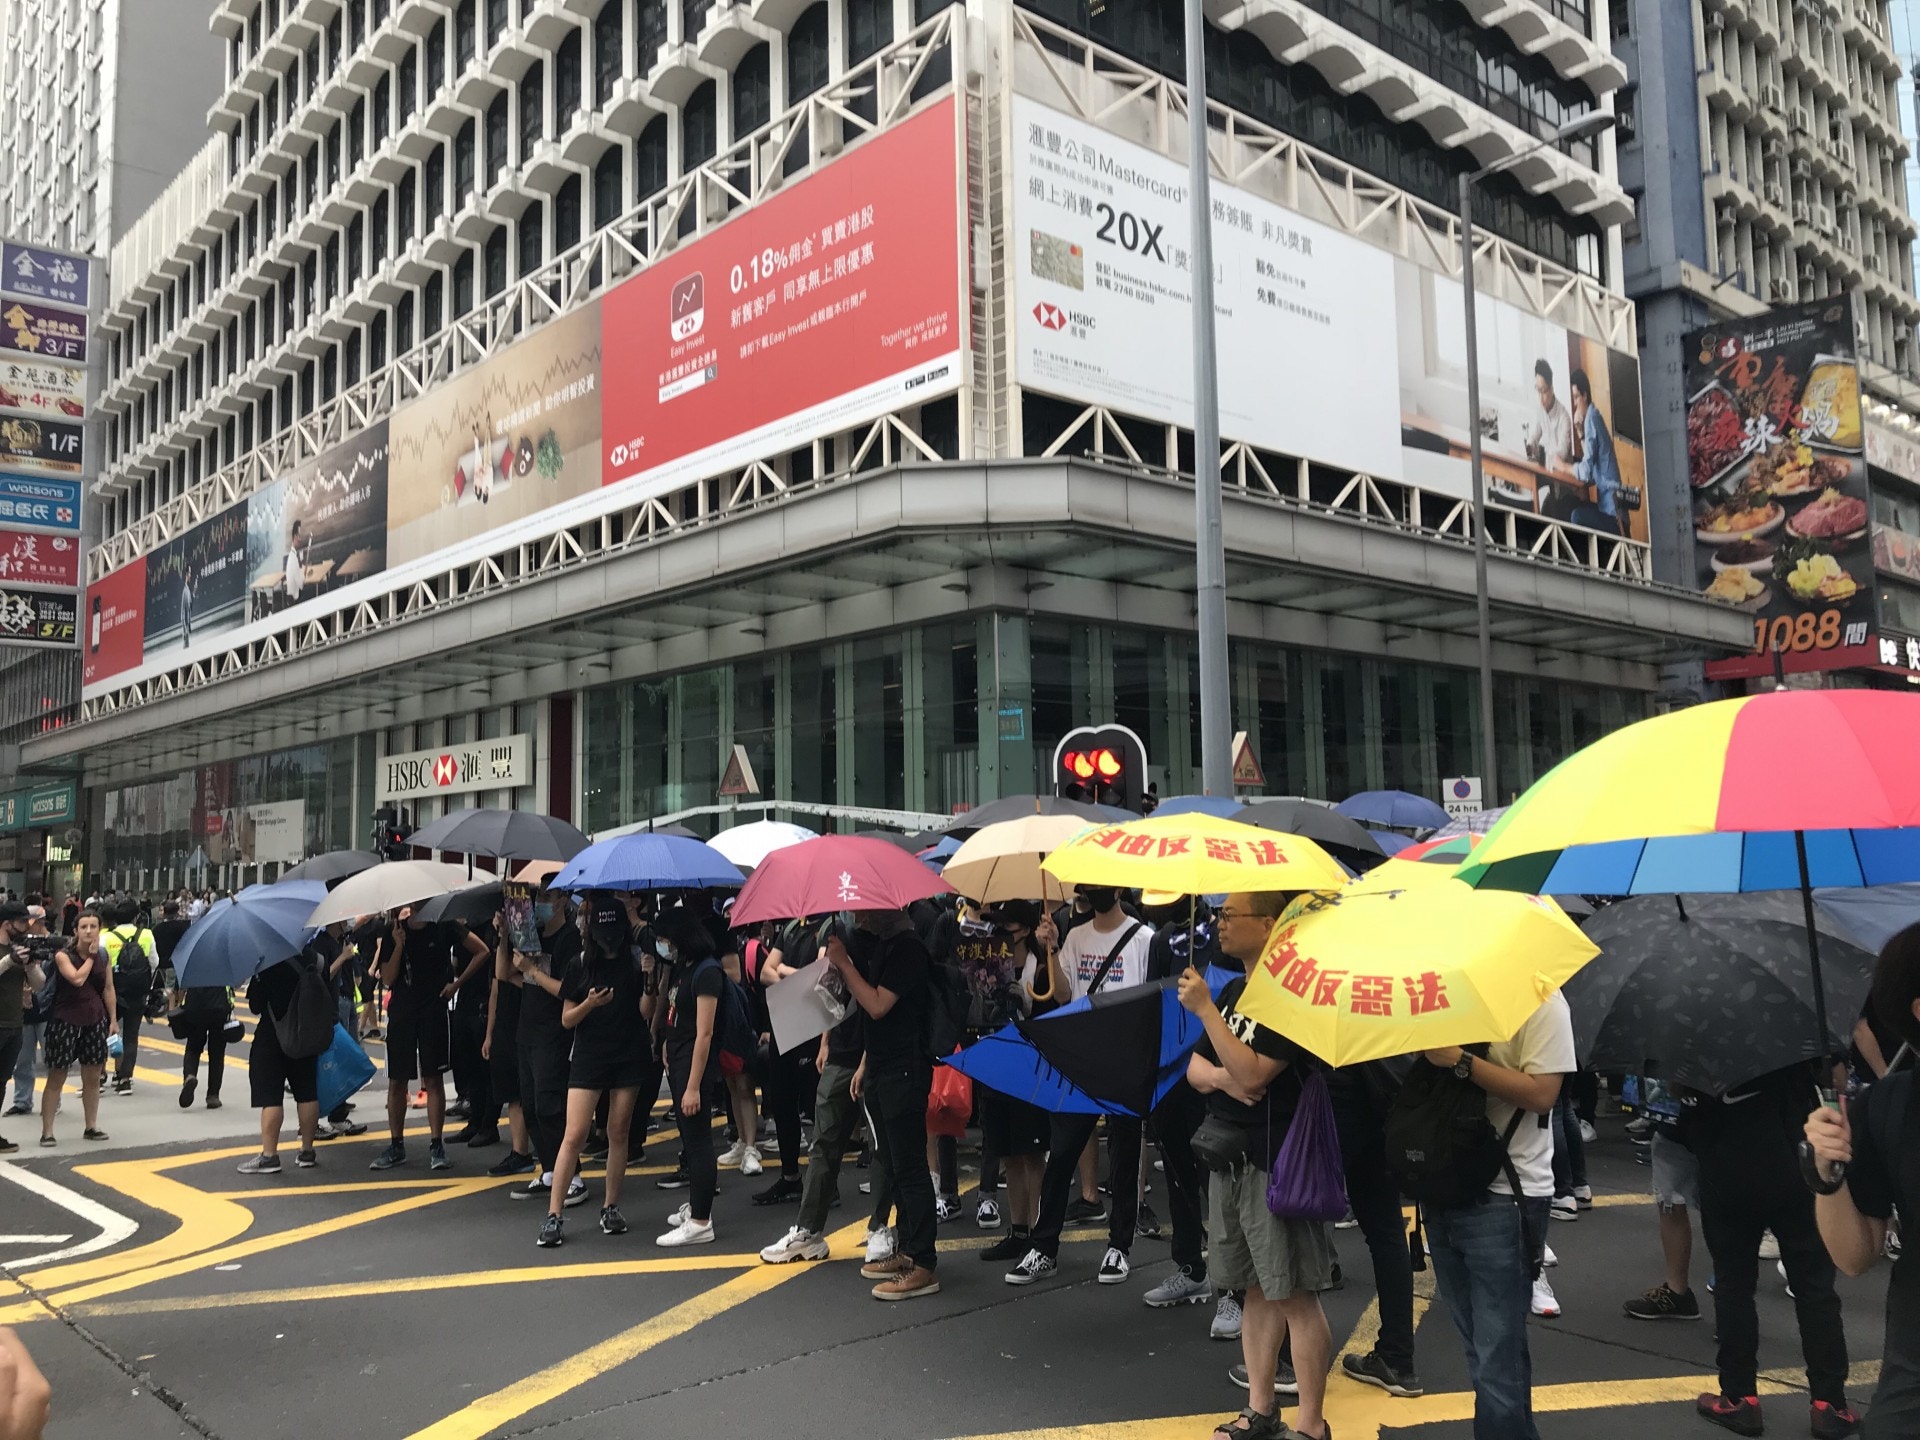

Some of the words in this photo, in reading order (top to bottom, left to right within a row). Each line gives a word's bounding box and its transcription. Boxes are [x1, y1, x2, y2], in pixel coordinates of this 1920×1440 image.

[1029, 122, 1096, 171] 滙豐公司
[1262, 219, 1313, 257] 非凡獎賞
[821, 204, 874, 250] 買賣港股
[1029, 176, 1093, 219] 網上消費
[1096, 202, 1166, 263] 20X
[730, 288, 776, 329] 新舊客戶
[783, 241, 874, 304] 同享無上限優惠
[881, 326, 911, 347] Together
[913, 321, 925, 333] we
[927, 311, 948, 328] thrive
[1069, 309, 1096, 329] HSBC
[46, 338, 78, 357] 3/F
[671, 344, 685, 358] Easy
[686, 333, 705, 351] Invest
[50, 432, 79, 453] 1/F
[629, 436, 645, 451] HSBC
[8, 483, 64, 498] watsons
[41, 623, 74, 638] 5/F
[1754, 609, 1841, 654] 1088
[387, 757, 431, 793] HSBC
[461, 746, 512, 784] 滙豐
[32, 798, 54, 813] watsons
[1448, 804, 1461, 813] 24
[1463, 803, 1478, 813] hrs
[837, 870, 861, 903] 皇仁
